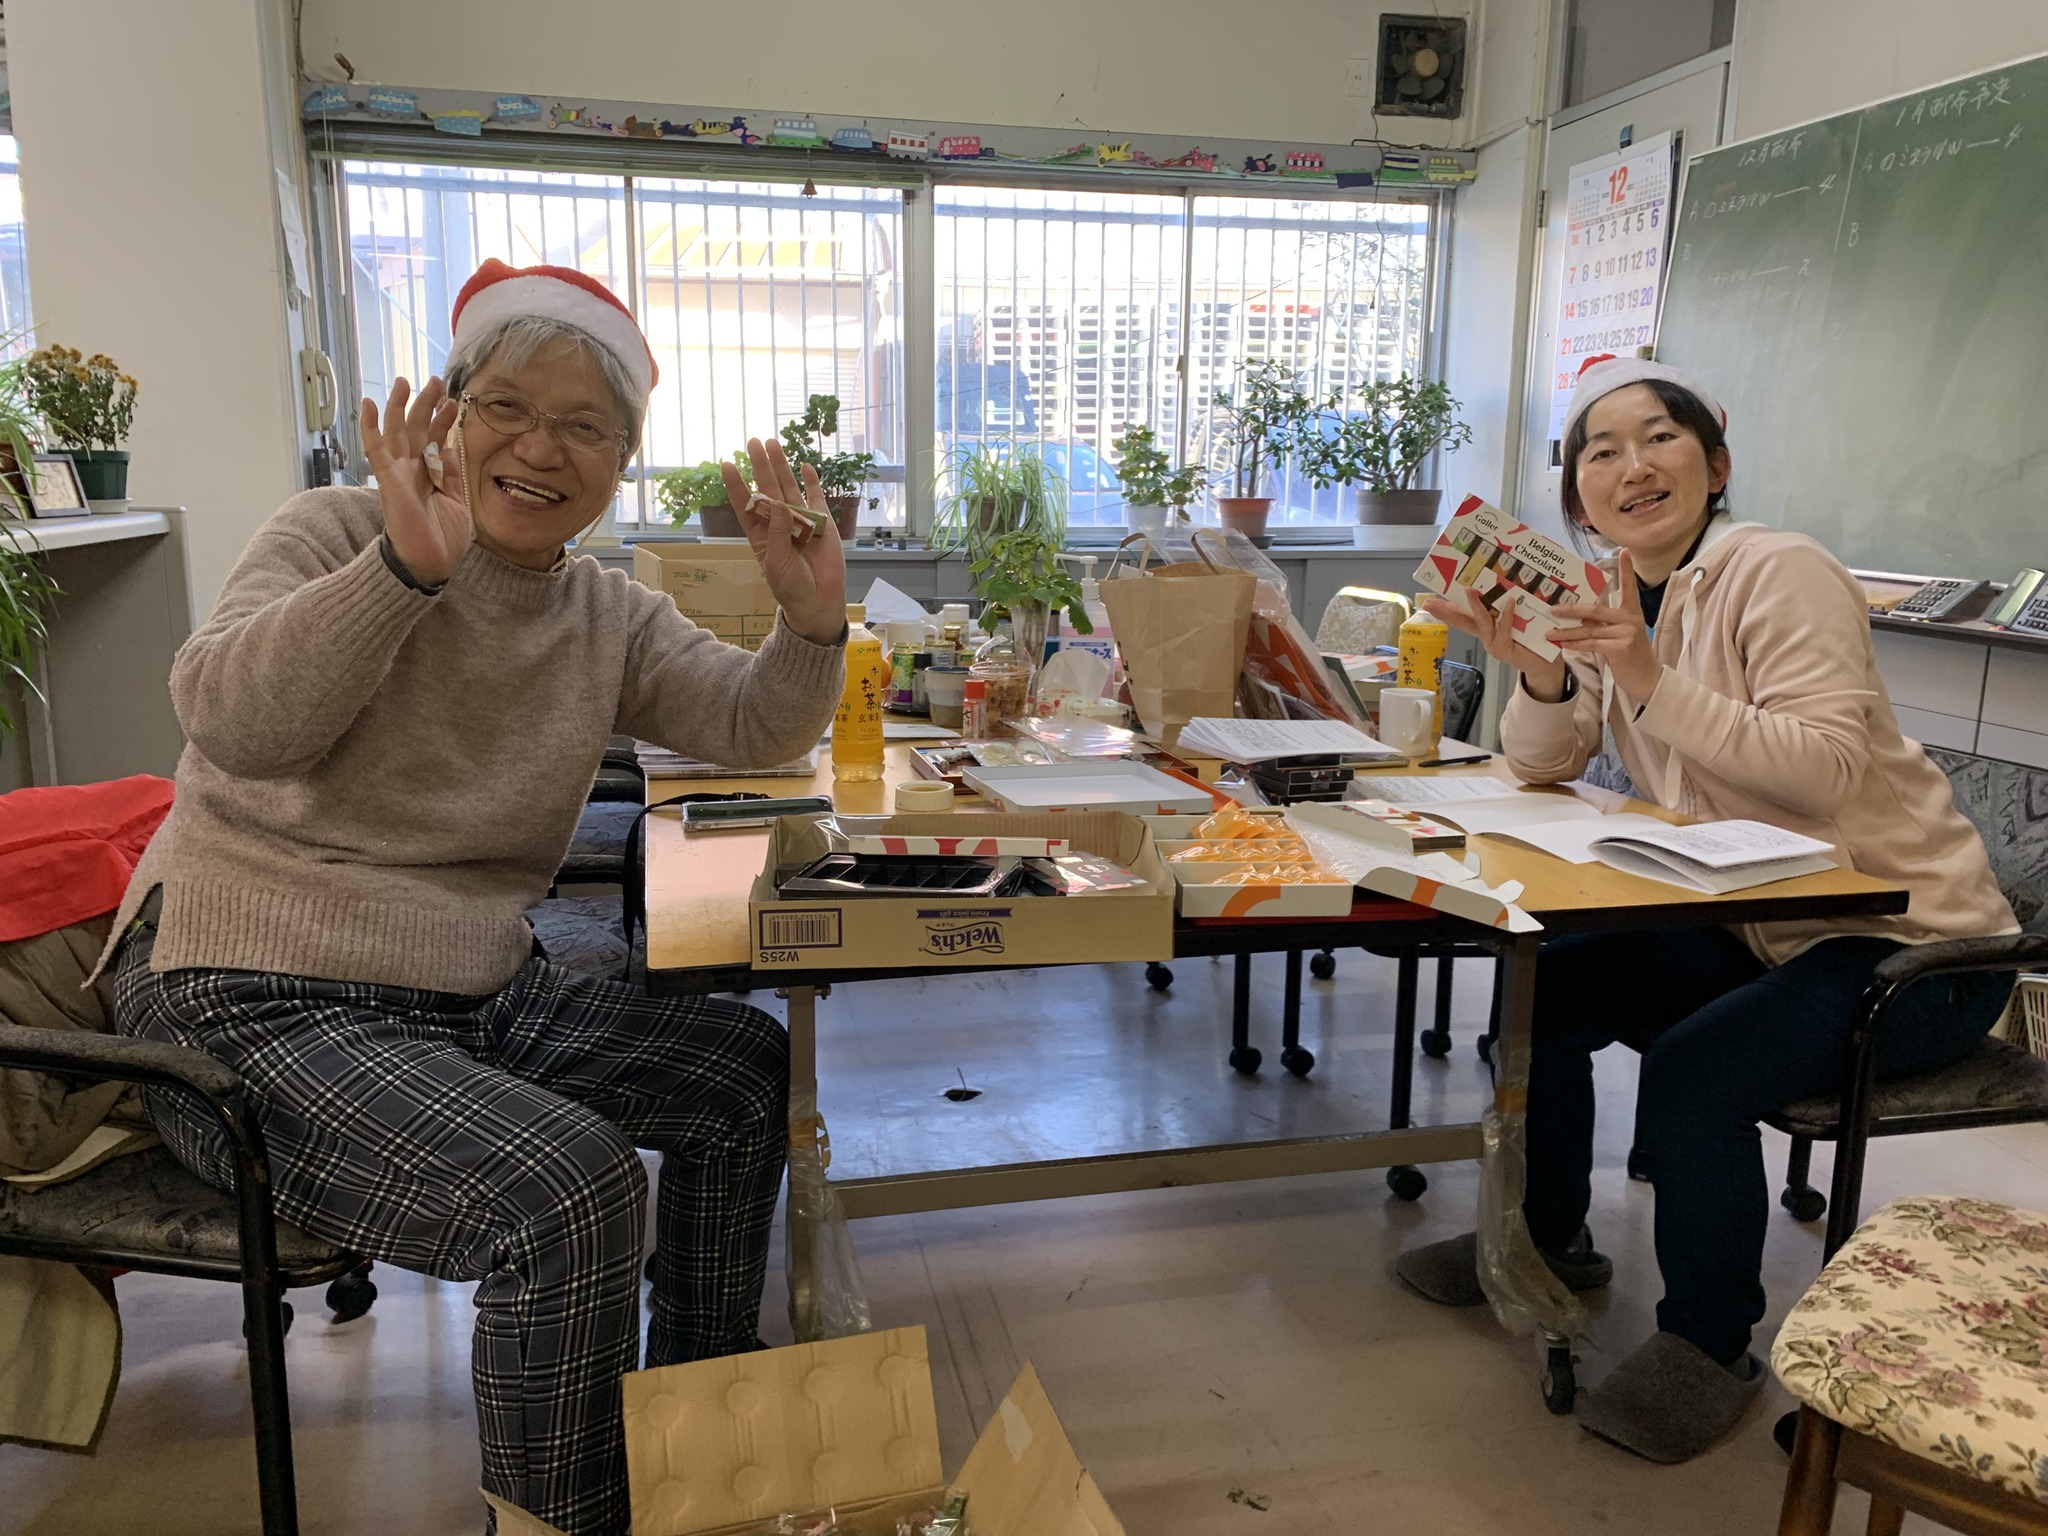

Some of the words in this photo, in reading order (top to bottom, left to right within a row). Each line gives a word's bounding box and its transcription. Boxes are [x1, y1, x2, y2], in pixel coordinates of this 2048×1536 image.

[1609, 166, 1628, 205] 12
[1819, 174, 1837, 195] 4
[1585, 227, 1591, 246] 1
[1598, 223, 1606, 243] 2
[1610, 220, 1617, 239] 3
[1622, 216, 1630, 235] 4
[1636, 212, 1645, 232] 5
[1651, 208, 1659, 229] 6
[1569, 266, 1576, 285] 7
[1582, 264, 1589, 282] 8
[1594, 261, 1601, 279] 9
[1606, 257, 1615, 276] 10
[1618, 254, 1628, 274] 11
[1632, 250, 1643, 271] 12
[1645, 247, 1657, 268] 13
[1565, 302, 1575, 320] 14
[1577, 299, 1588, 318] 15
[1590, 297, 1600, 316] 16
[1602, 294, 1612, 314] 17
[1614, 291, 1625, 311] 18
[1627, 289, 1639, 309] 19
[1640, 286, 1653, 307] 20
[1561, 338, 1572, 355] 21
[1573, 335, 1585, 354] 22
[1585, 332, 1597, 352] 23
[1597, 331, 1608, 350] 24
[1609, 329, 1622, 349] 25
[1622, 327, 1635, 347] 26
[1636, 325, 1649, 345] 27
[1558, 372, 1569, 390] 28
[1474, 513, 1499, 532] Galler
[1514, 543, 1567, 579] Chocolates
[1528, 537, 1565, 565] Belgian
[861, 677, 876, 711] お茶
[931, 926, 1002, 952] Welch's
[760, 951, 800, 963] W25S
